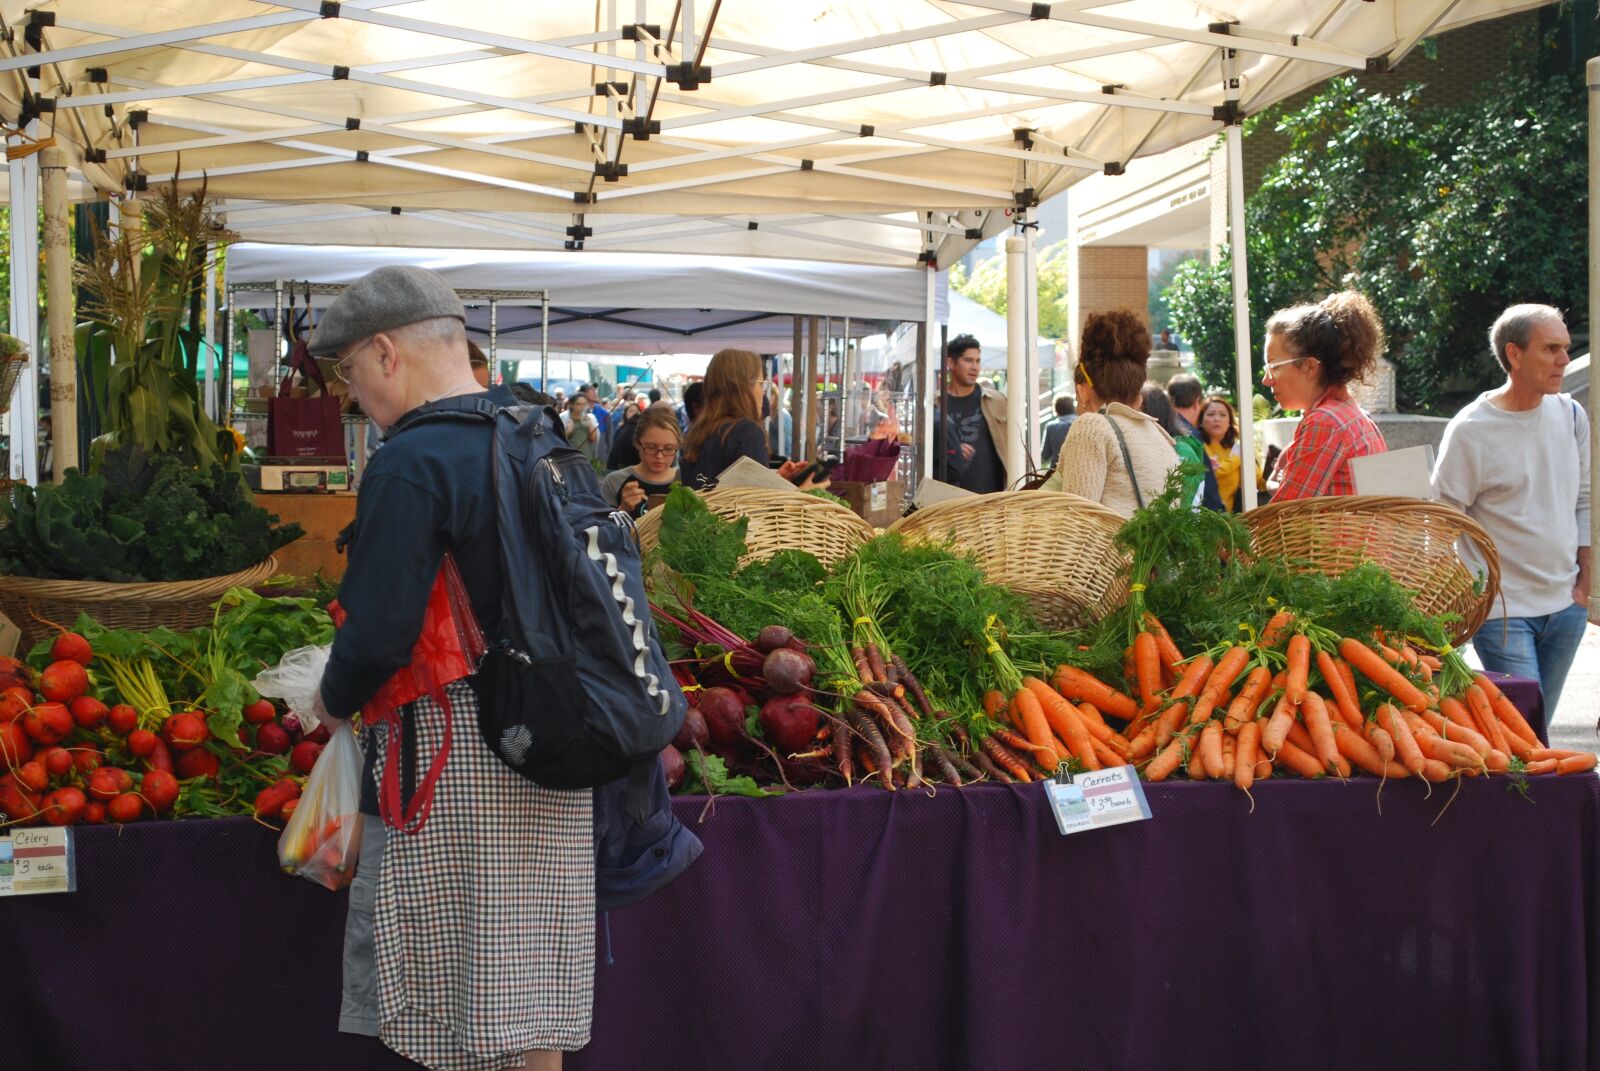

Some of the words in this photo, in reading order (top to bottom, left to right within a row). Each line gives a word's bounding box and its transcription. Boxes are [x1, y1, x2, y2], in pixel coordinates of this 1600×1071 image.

[1083, 772, 1122, 788] Carrots
[15, 831, 49, 846] Celery
[37, 863, 54, 872] each
